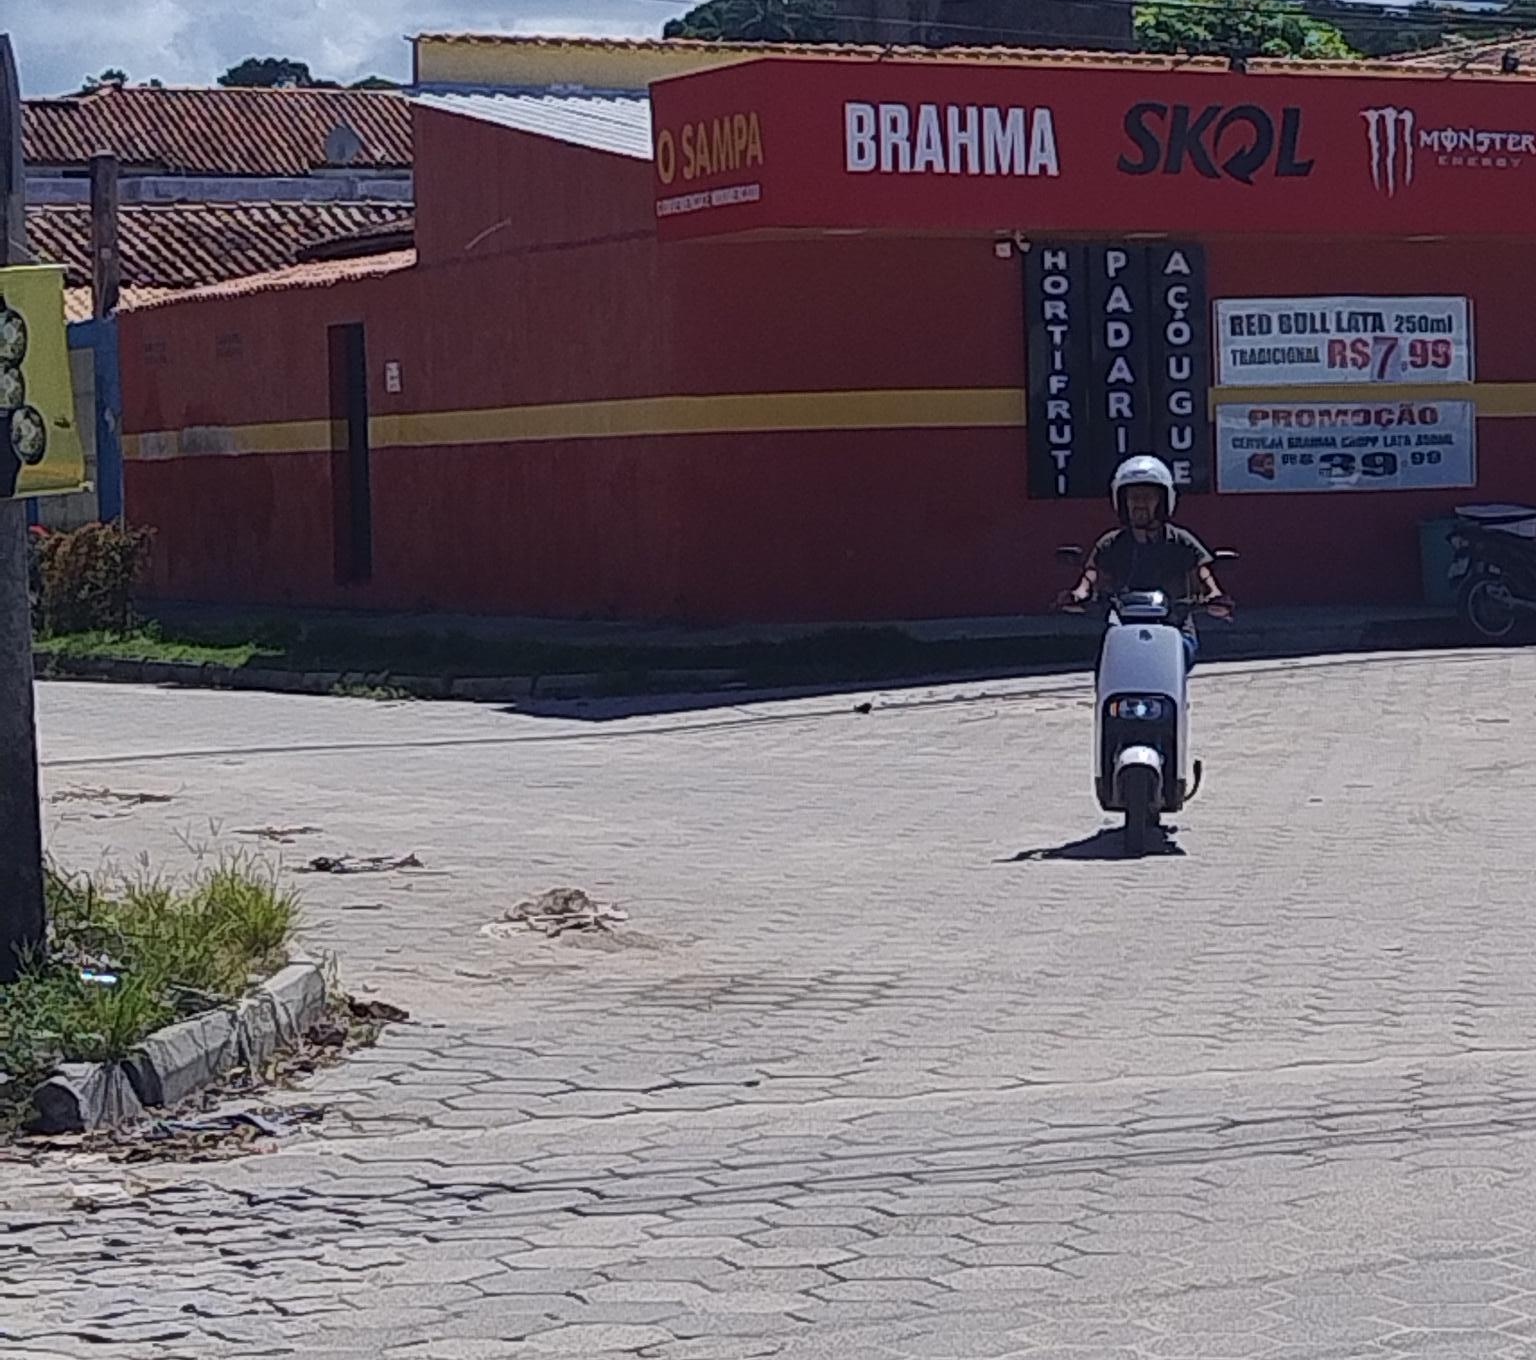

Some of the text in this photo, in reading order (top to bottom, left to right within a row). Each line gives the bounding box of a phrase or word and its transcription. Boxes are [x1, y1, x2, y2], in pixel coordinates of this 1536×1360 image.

[657, 111, 764, 184] O SAMPA
[844, 101, 1060, 177] BRAHMA
[1116, 102, 1315, 186] SKOL
[1438, 155, 1522, 168] ENERGY
[1105, 250, 1135, 454] PADARI
[1229, 313, 1273, 337] RED
[1278, 311, 1331, 335] BULL
[1335, 310, 1386, 333] LATA
[1230, 345, 1321, 366] TRADICIONAL
[1042, 249, 1072, 495] HORTIFRUTI
[1163, 250, 1194, 485] AÇOUGUE
[1247, 403, 1440, 429] PROMOÇÃO
